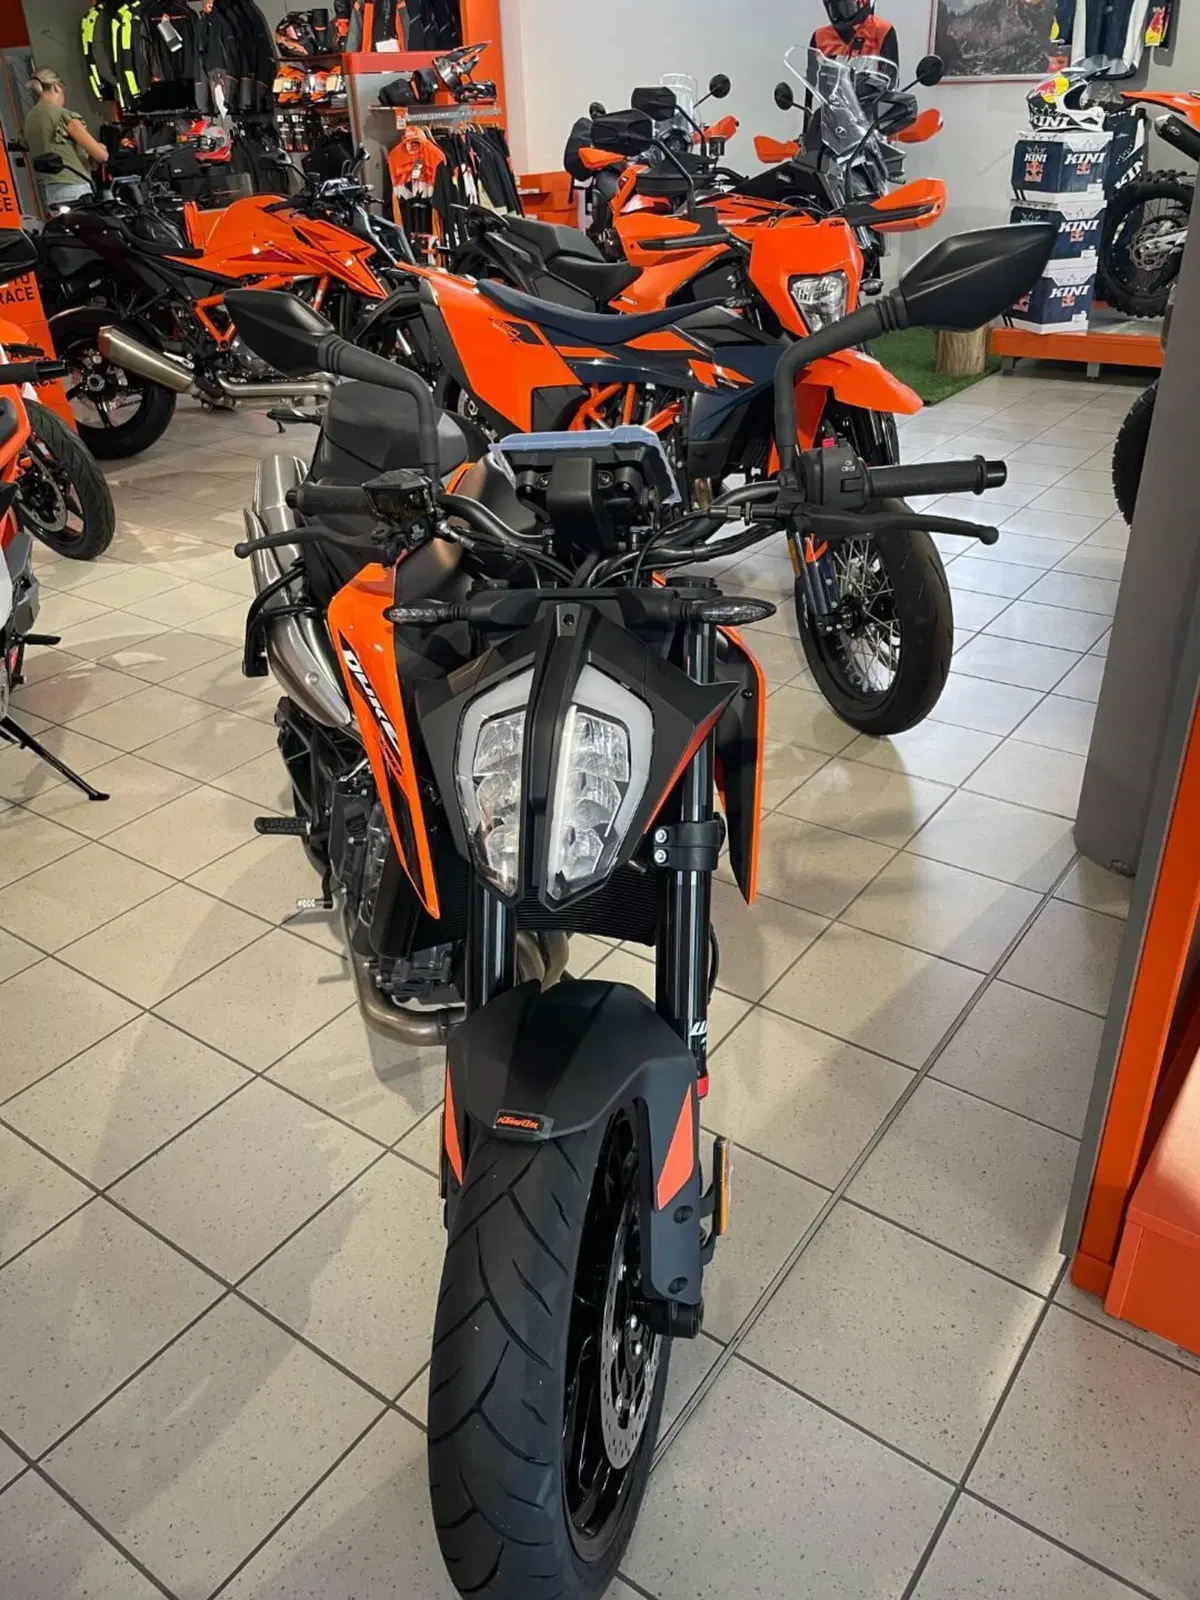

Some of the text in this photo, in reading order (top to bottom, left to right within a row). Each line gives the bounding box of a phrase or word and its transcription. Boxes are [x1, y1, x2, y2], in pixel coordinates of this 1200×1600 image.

[1024, 153, 1047, 162] KINI
[1064, 152, 1106, 165] KINI
[1058, 219, 1100, 233] KINI
[1049, 285, 1091, 299] KINI
[342, 650, 402, 758] DUKE
